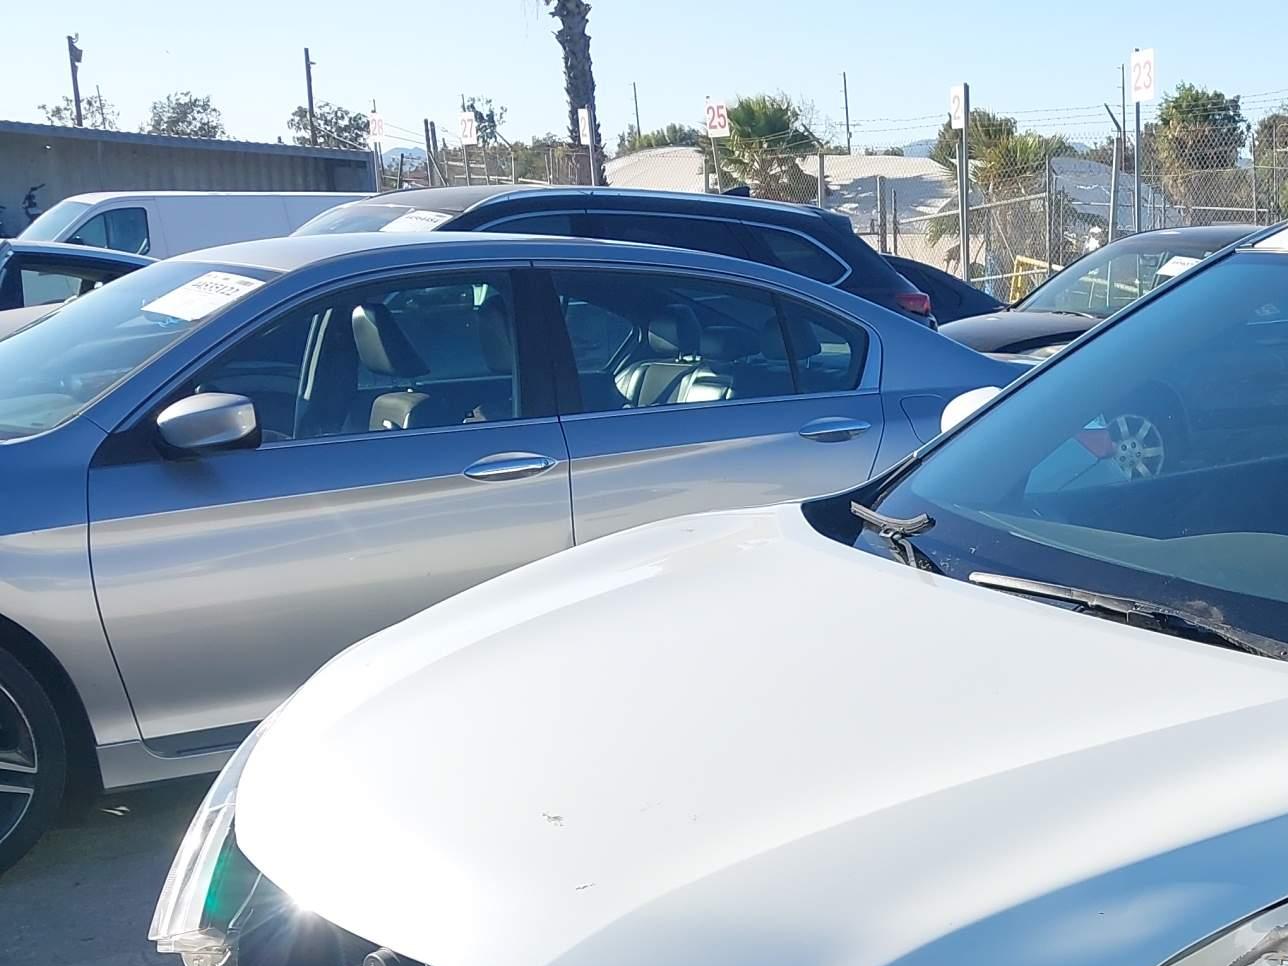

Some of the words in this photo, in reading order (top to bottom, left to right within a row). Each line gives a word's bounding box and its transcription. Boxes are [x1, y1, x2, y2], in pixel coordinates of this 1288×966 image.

[1133, 60, 1152, 91] 23
[371, 118, 384, 137] 28
[706, 104, 726, 129] 25
[461, 118, 473, 138] 27
